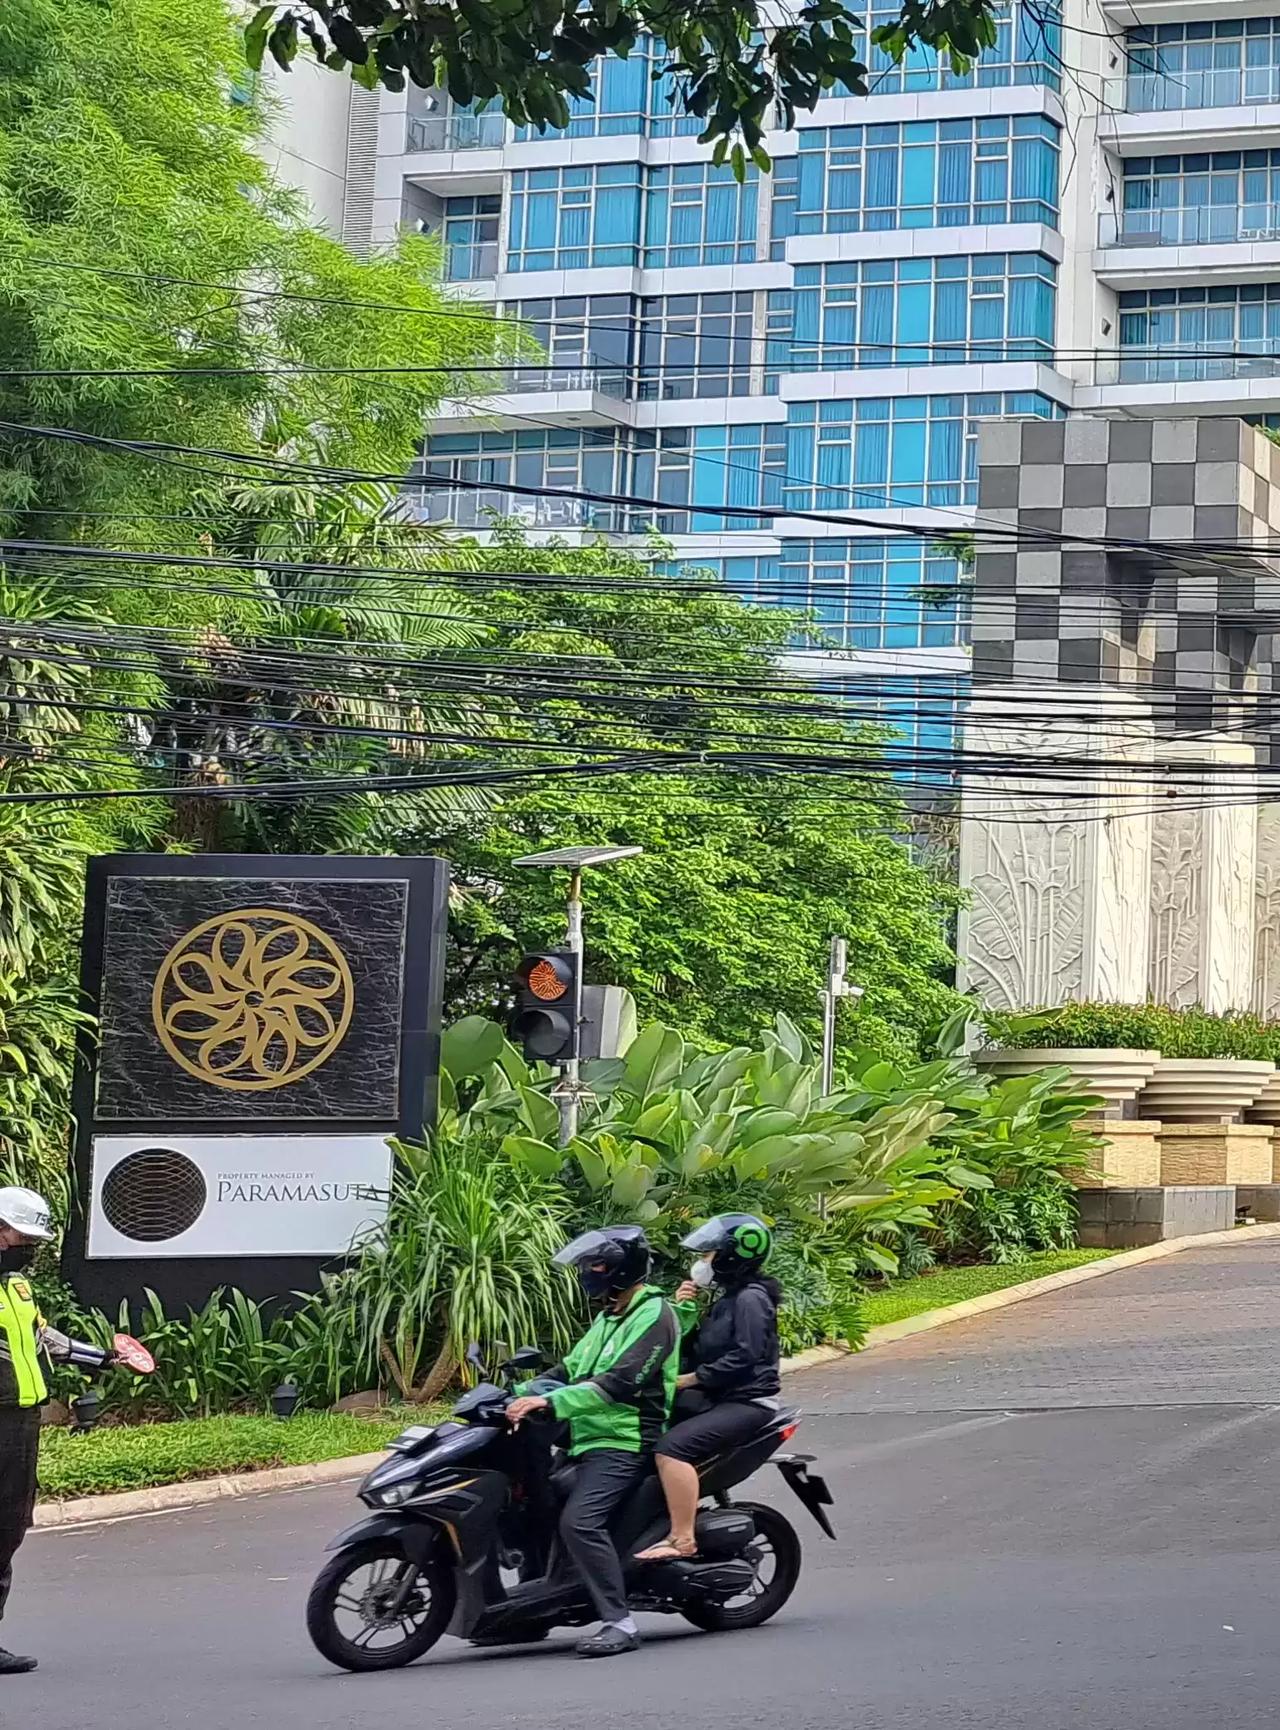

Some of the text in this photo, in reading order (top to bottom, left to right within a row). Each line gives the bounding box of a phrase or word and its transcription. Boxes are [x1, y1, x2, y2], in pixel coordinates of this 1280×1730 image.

[217, 1172, 315, 1180] PROPERTY MANAGED BY
